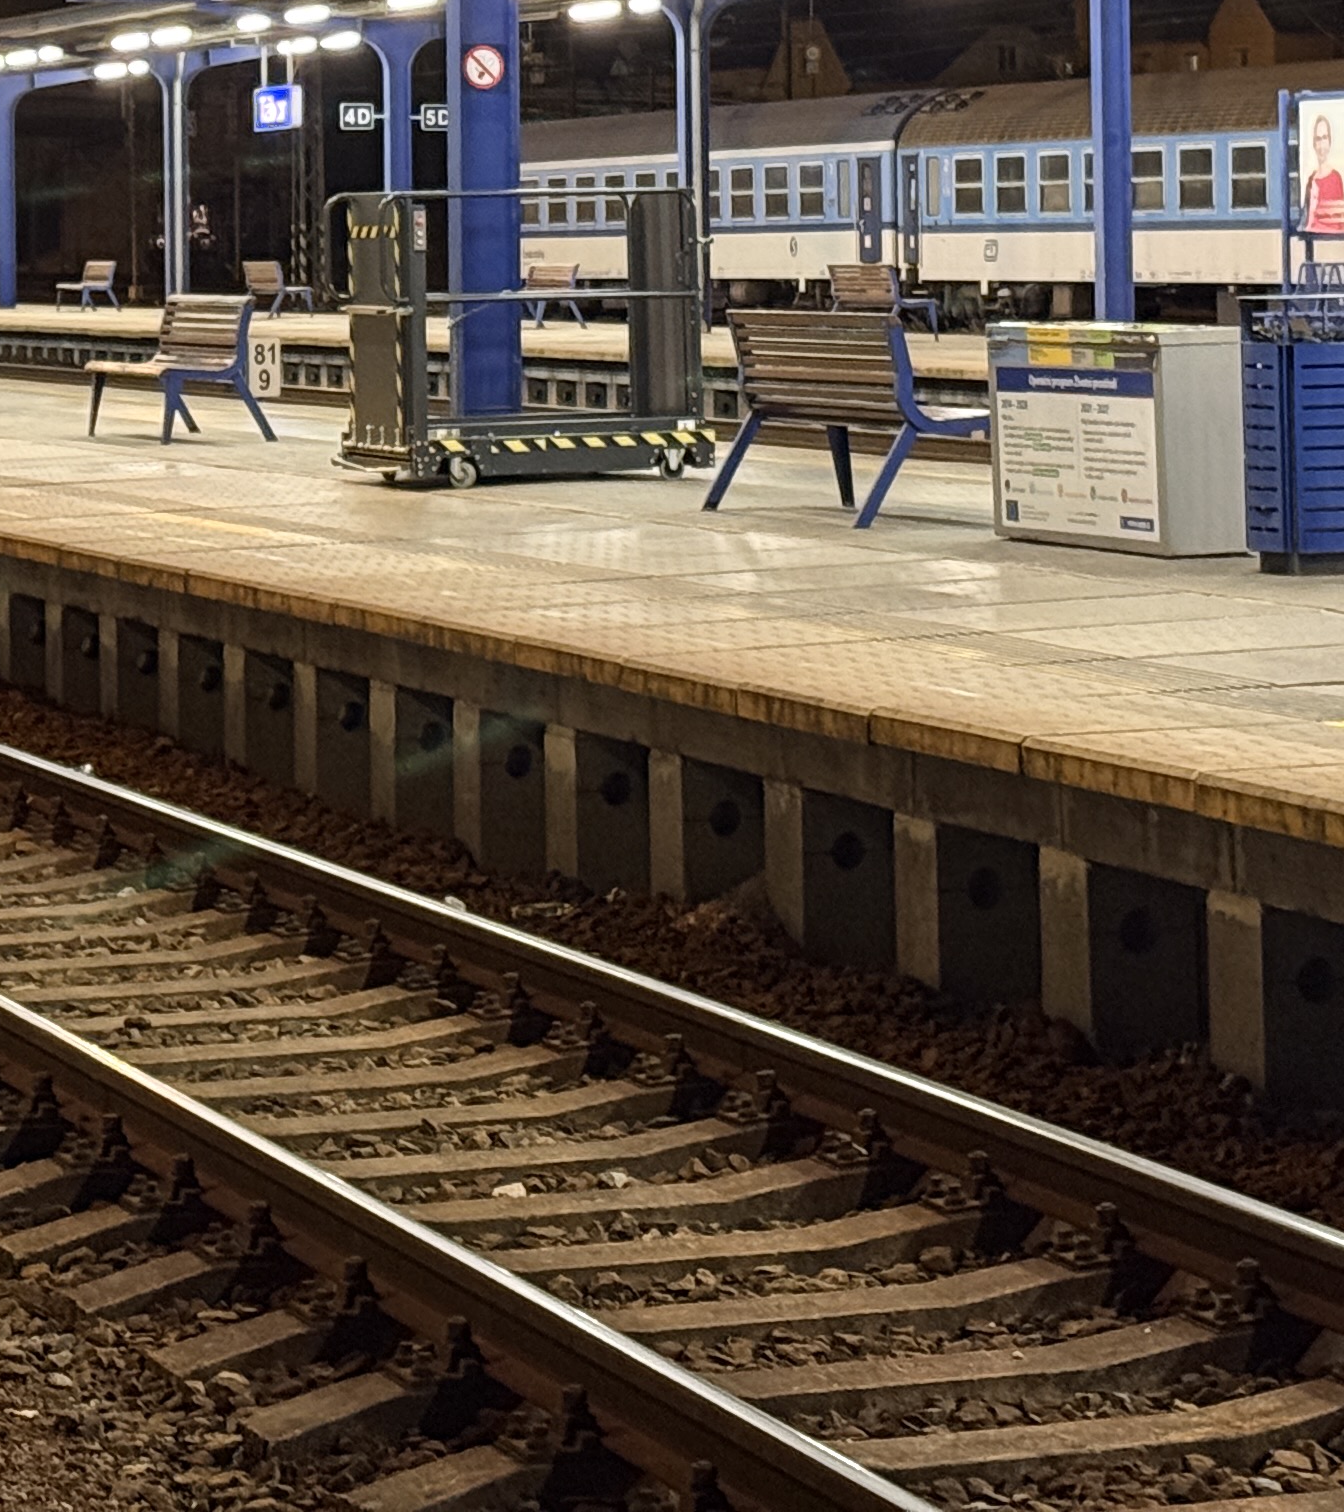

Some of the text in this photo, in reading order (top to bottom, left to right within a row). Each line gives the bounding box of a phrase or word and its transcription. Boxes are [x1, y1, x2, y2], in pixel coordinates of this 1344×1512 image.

[344, 108, 371, 125] 4D
[254, 343, 276, 365] 81
[259, 369, 270, 391] 9
